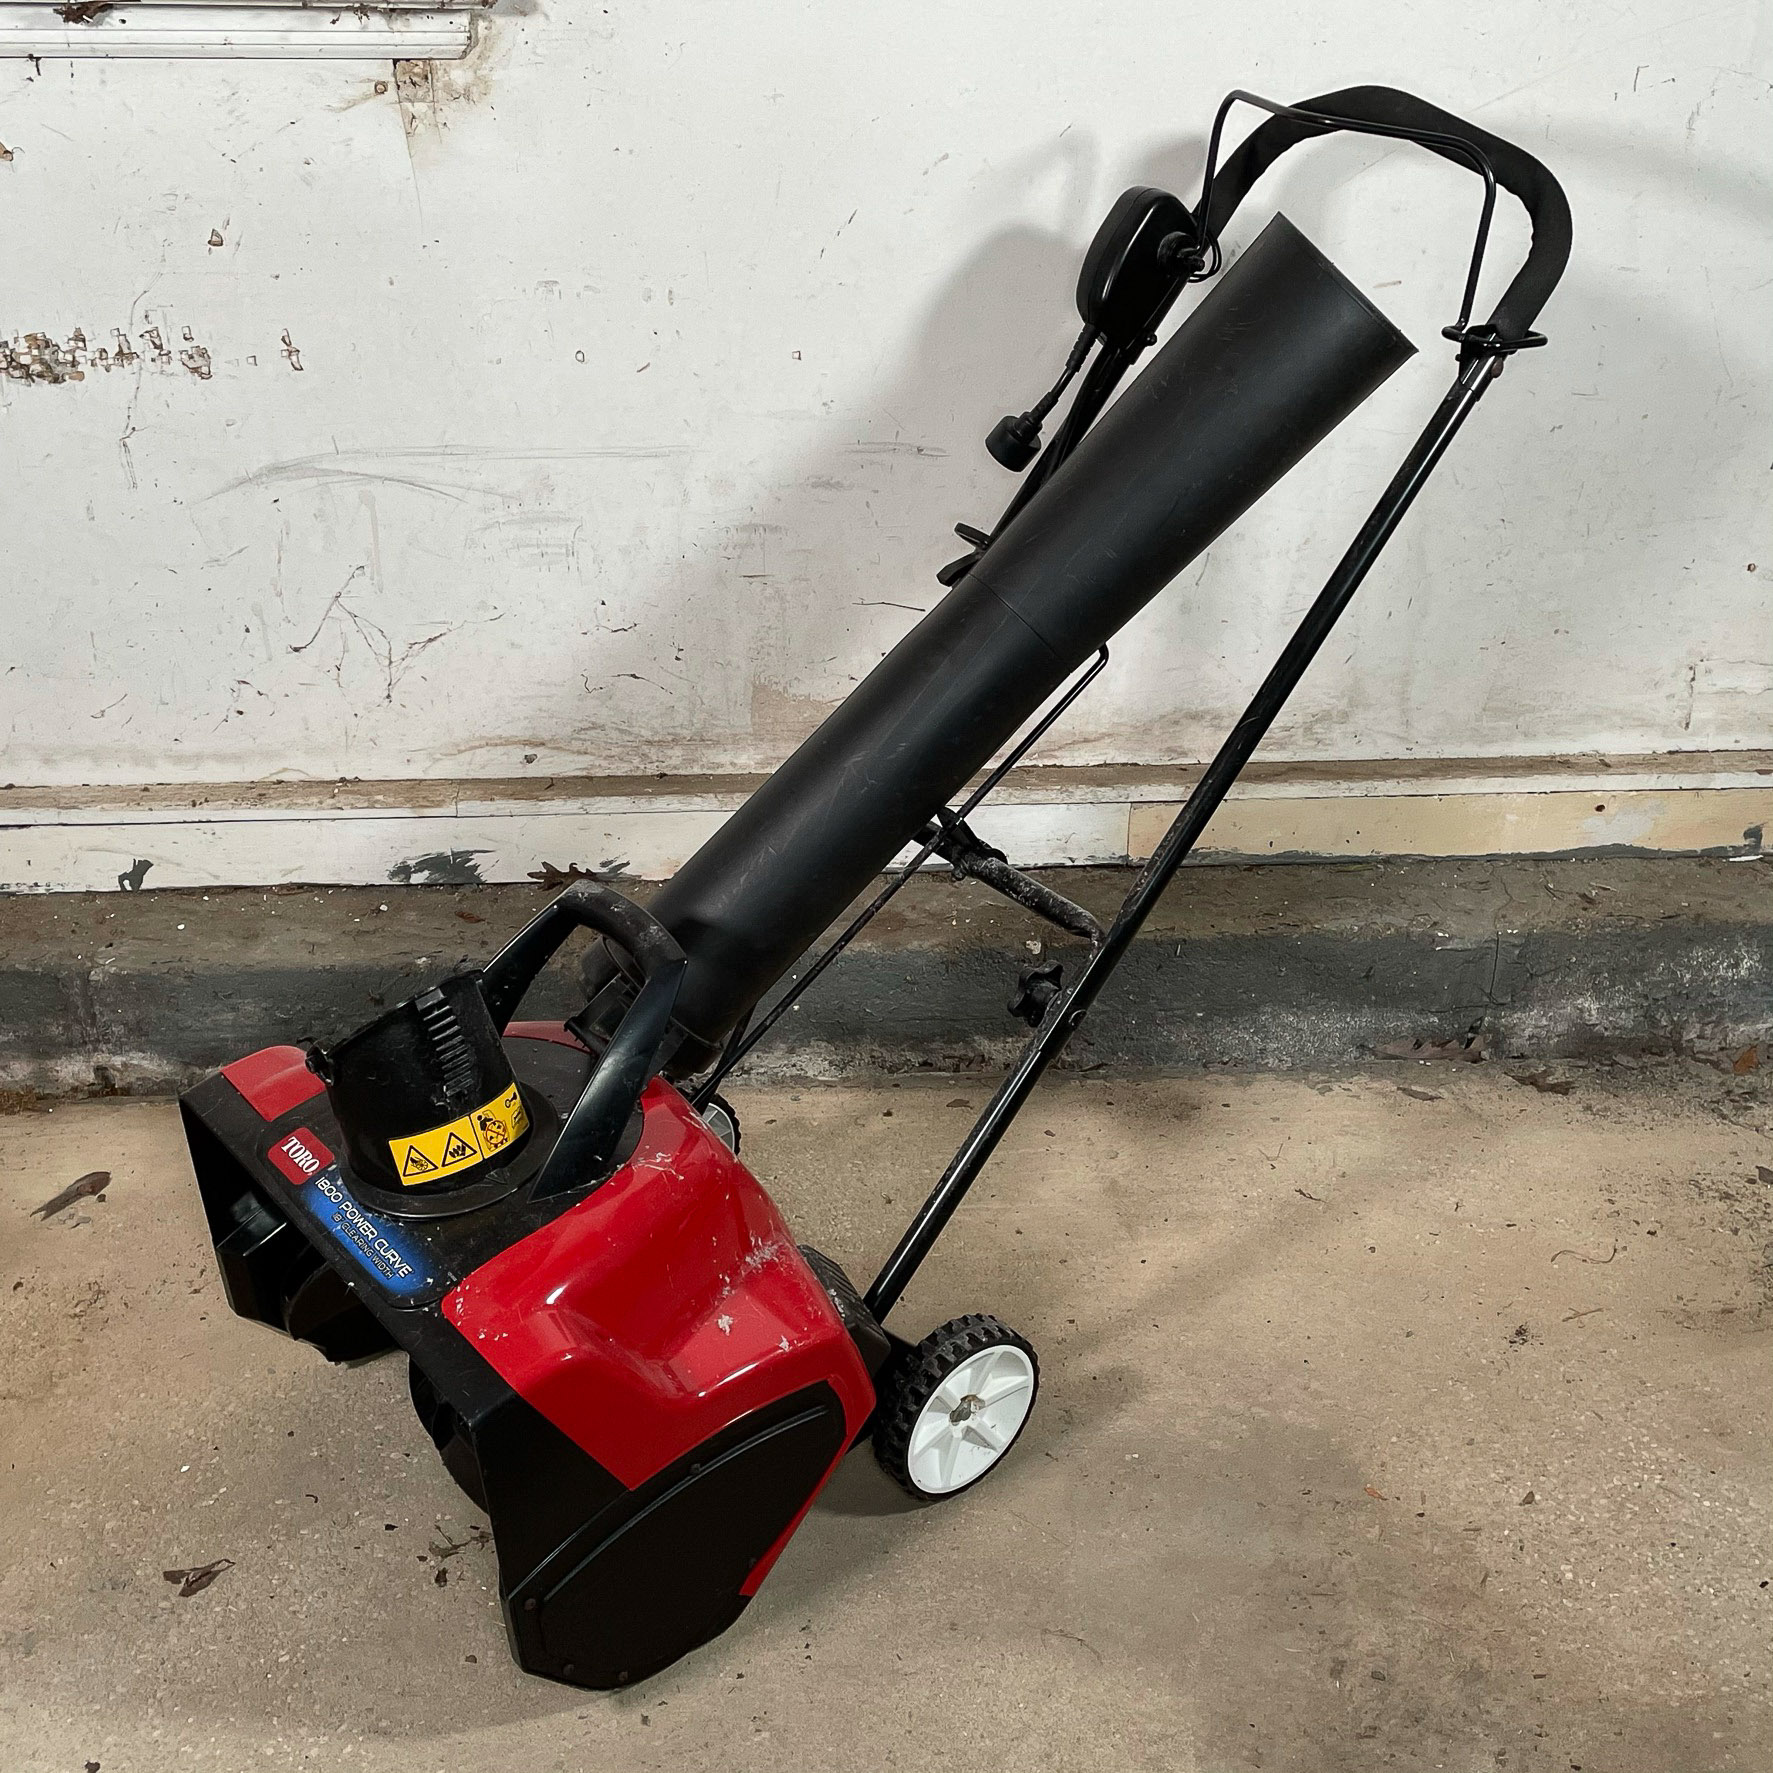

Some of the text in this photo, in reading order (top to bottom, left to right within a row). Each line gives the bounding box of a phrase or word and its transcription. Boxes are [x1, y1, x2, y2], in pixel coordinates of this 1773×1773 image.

[281, 1136, 320, 1174] TORO
[316, 1176, 413, 1277] 1800 POWER CURVE
[341, 1223, 374, 1257] CLEARING
[372, 1255, 394, 1279] WIDTH
